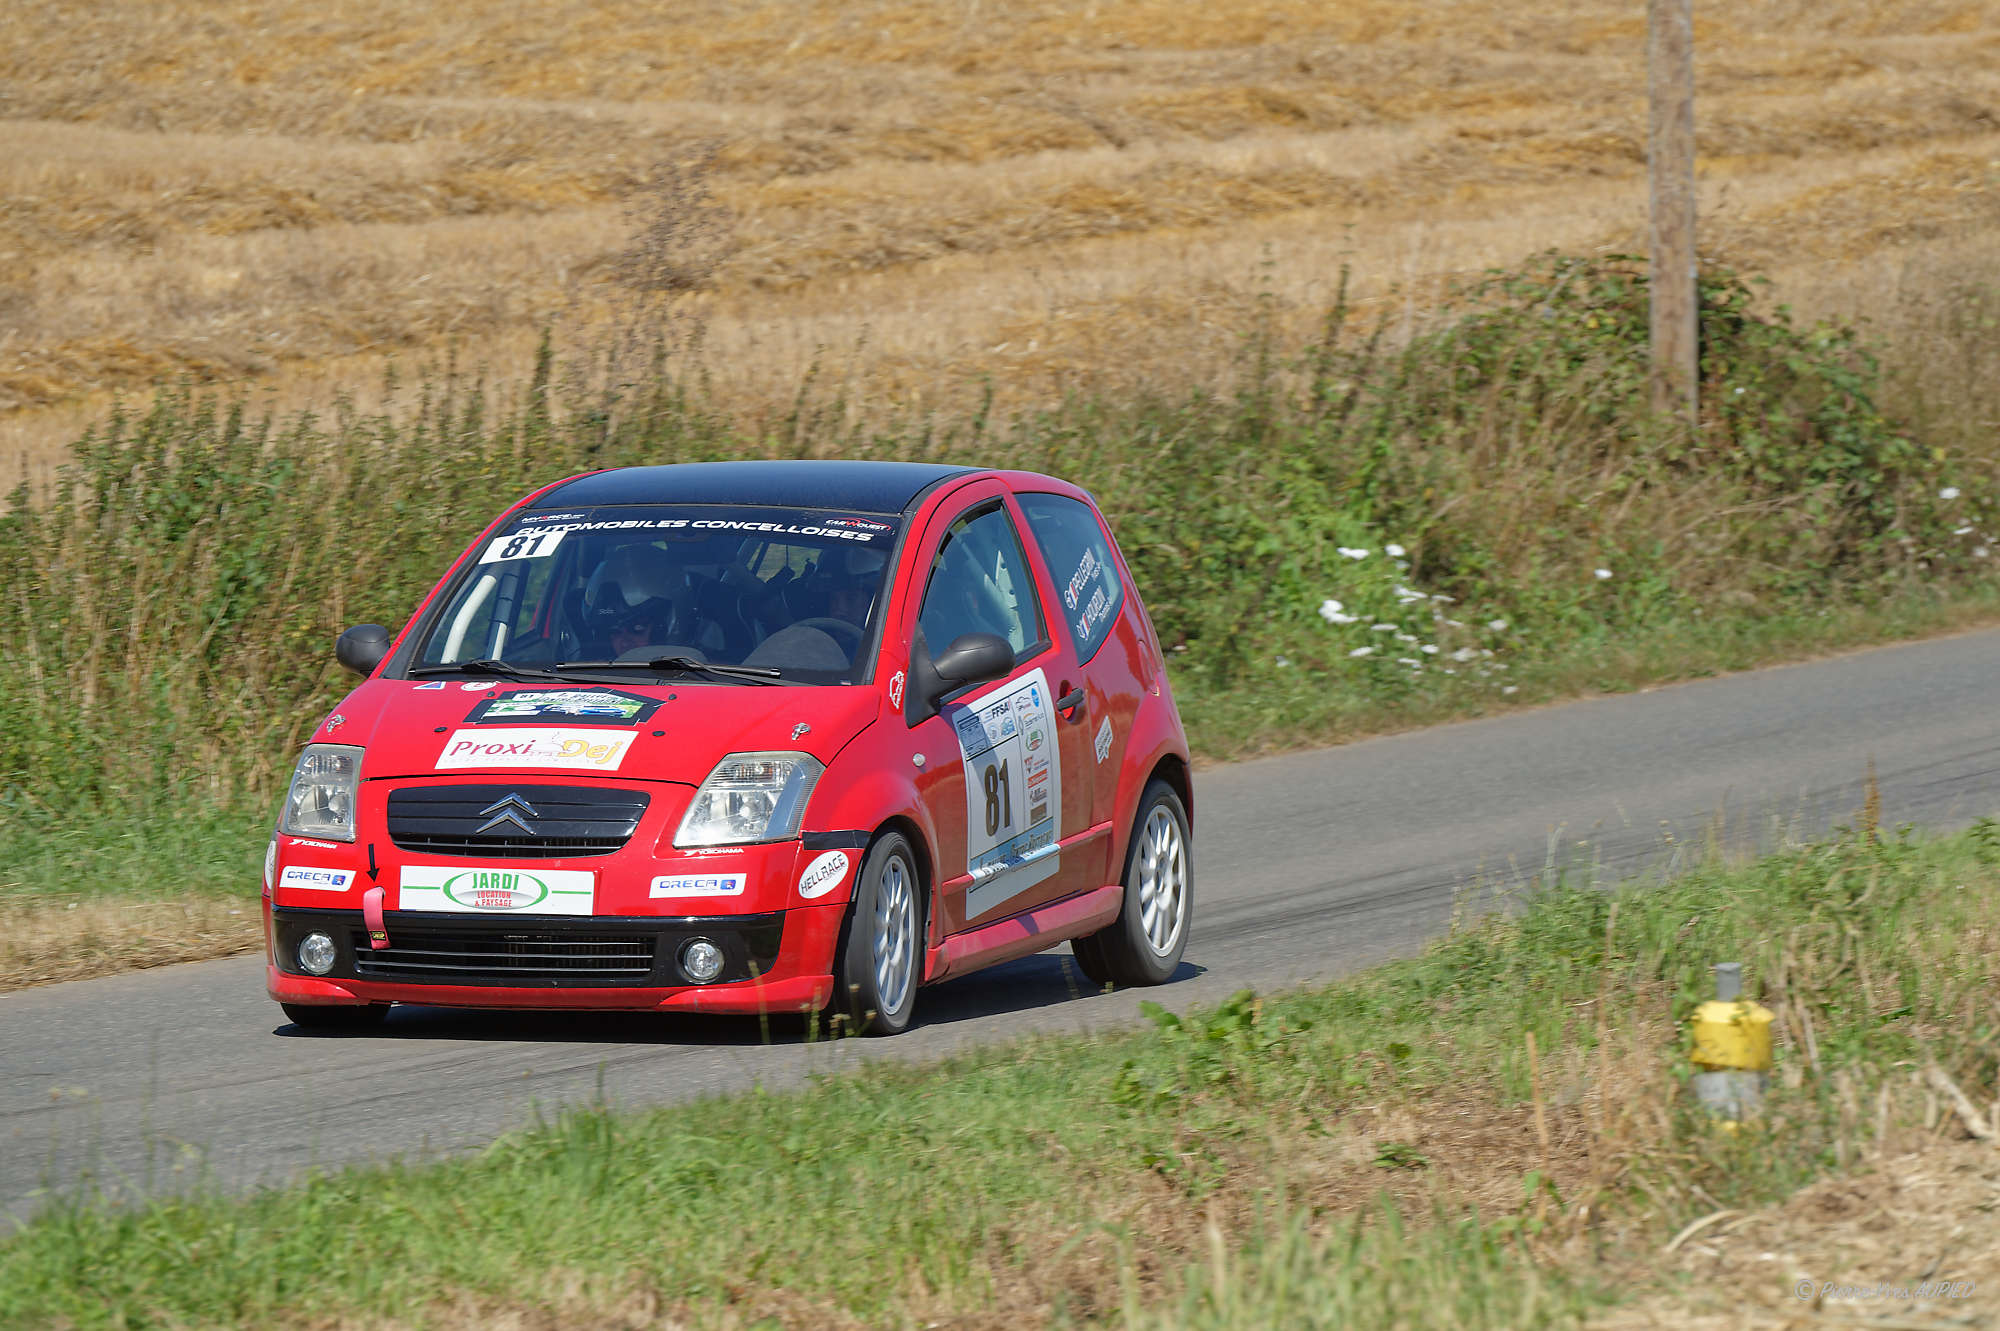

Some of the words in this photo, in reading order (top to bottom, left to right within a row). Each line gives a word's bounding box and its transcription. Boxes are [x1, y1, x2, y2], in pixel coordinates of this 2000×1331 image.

[514, 520, 689, 536] AUTOMOBILES
[691, 520, 874, 542] CONCELLOISES
[500, 534, 547, 558] 81
[449, 739, 536, 757] Proxi
[558, 739, 624, 764] Dej
[984, 758, 1010, 837] 81
[472, 873, 519, 890] JARDI
[800, 853, 846, 894] HELLRACE
[477, 890, 511, 899] LOCATION
[481, 899, 512, 908] PAYSAGE
